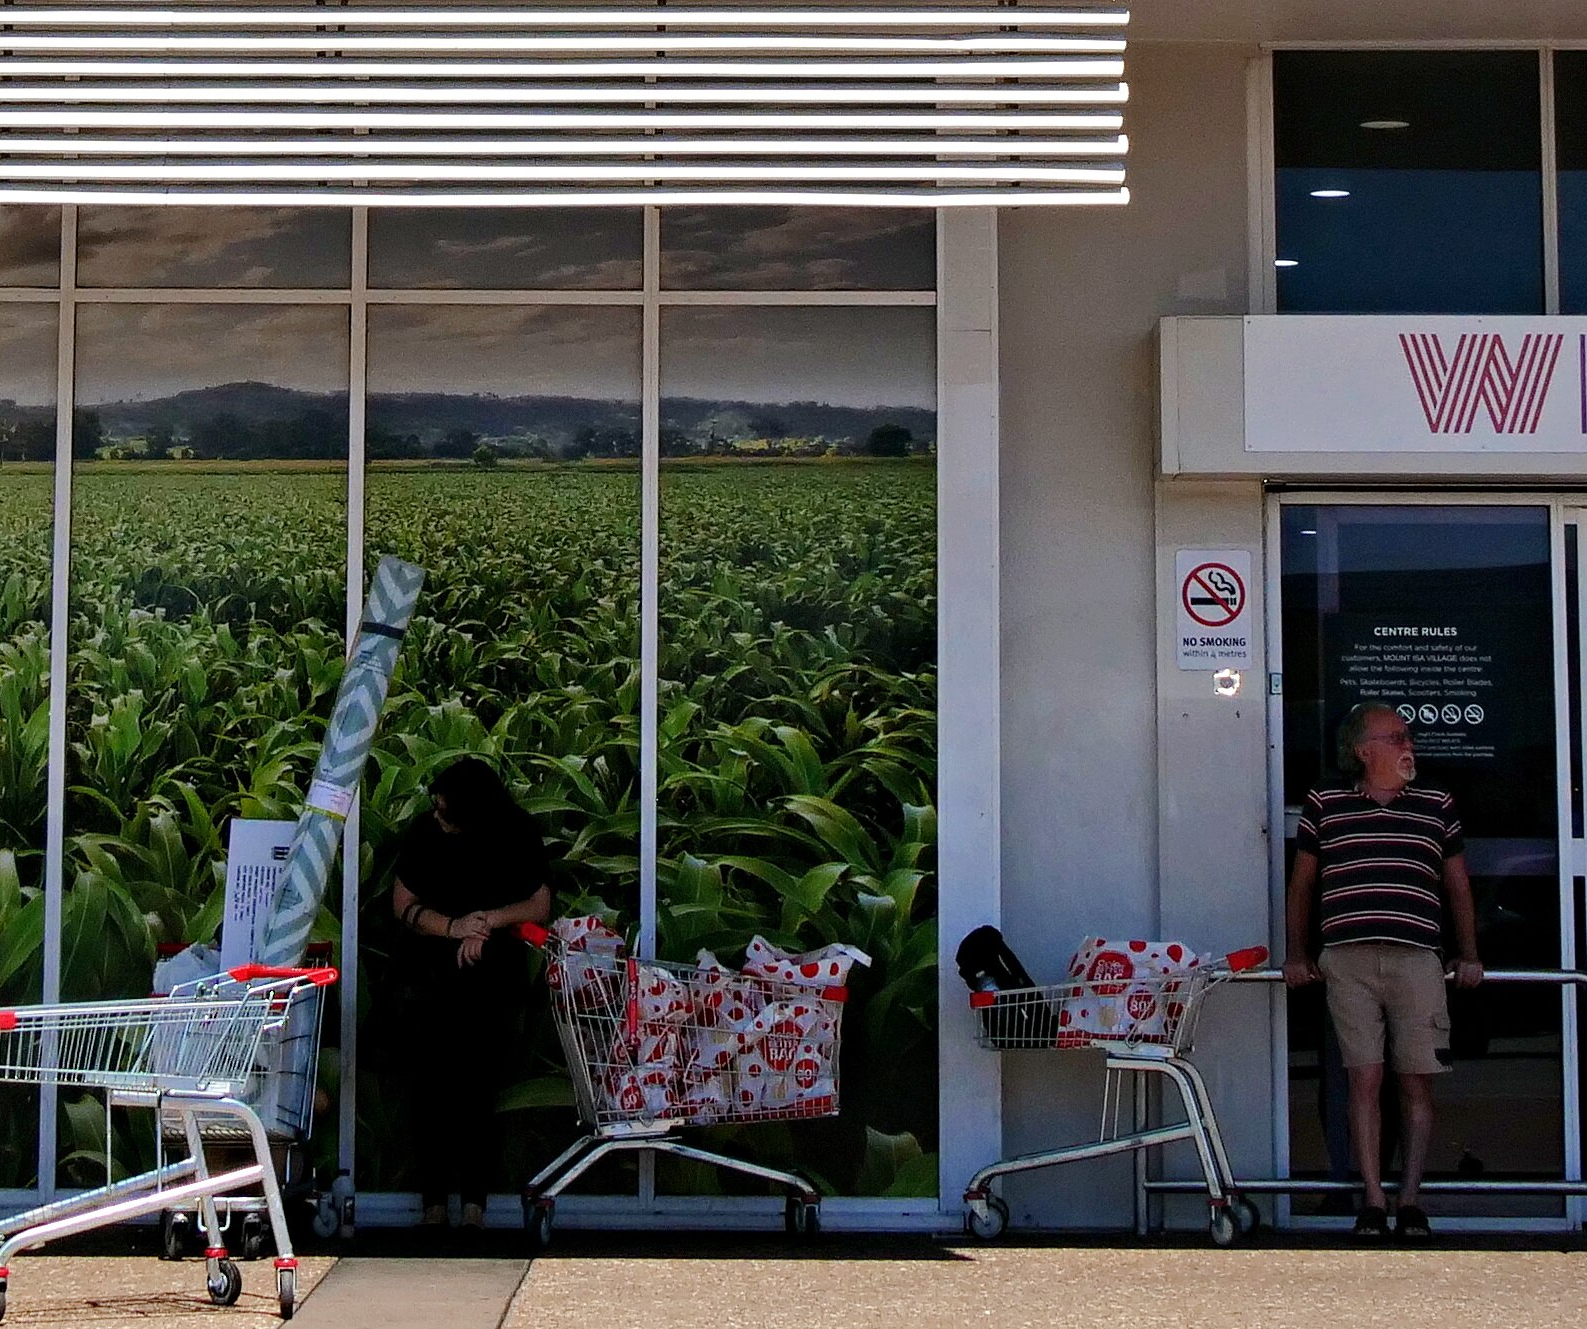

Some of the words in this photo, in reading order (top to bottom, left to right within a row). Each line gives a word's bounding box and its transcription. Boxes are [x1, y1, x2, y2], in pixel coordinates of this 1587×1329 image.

[1373, 626, 1419, 637] CENTRE
[1421, 626, 1458, 637] RULES
[1182, 637, 1198, 647] NO
[1199, 637, 1247, 647] SMOKING
[1182, 649, 1209, 658] within
[1218, 650, 1247, 659] metres
[1383, 653, 1411, 662] MOUNT
[1412, 654, 1425, 663] ISA
[1426, 654, 1458, 663] VILLAGE
